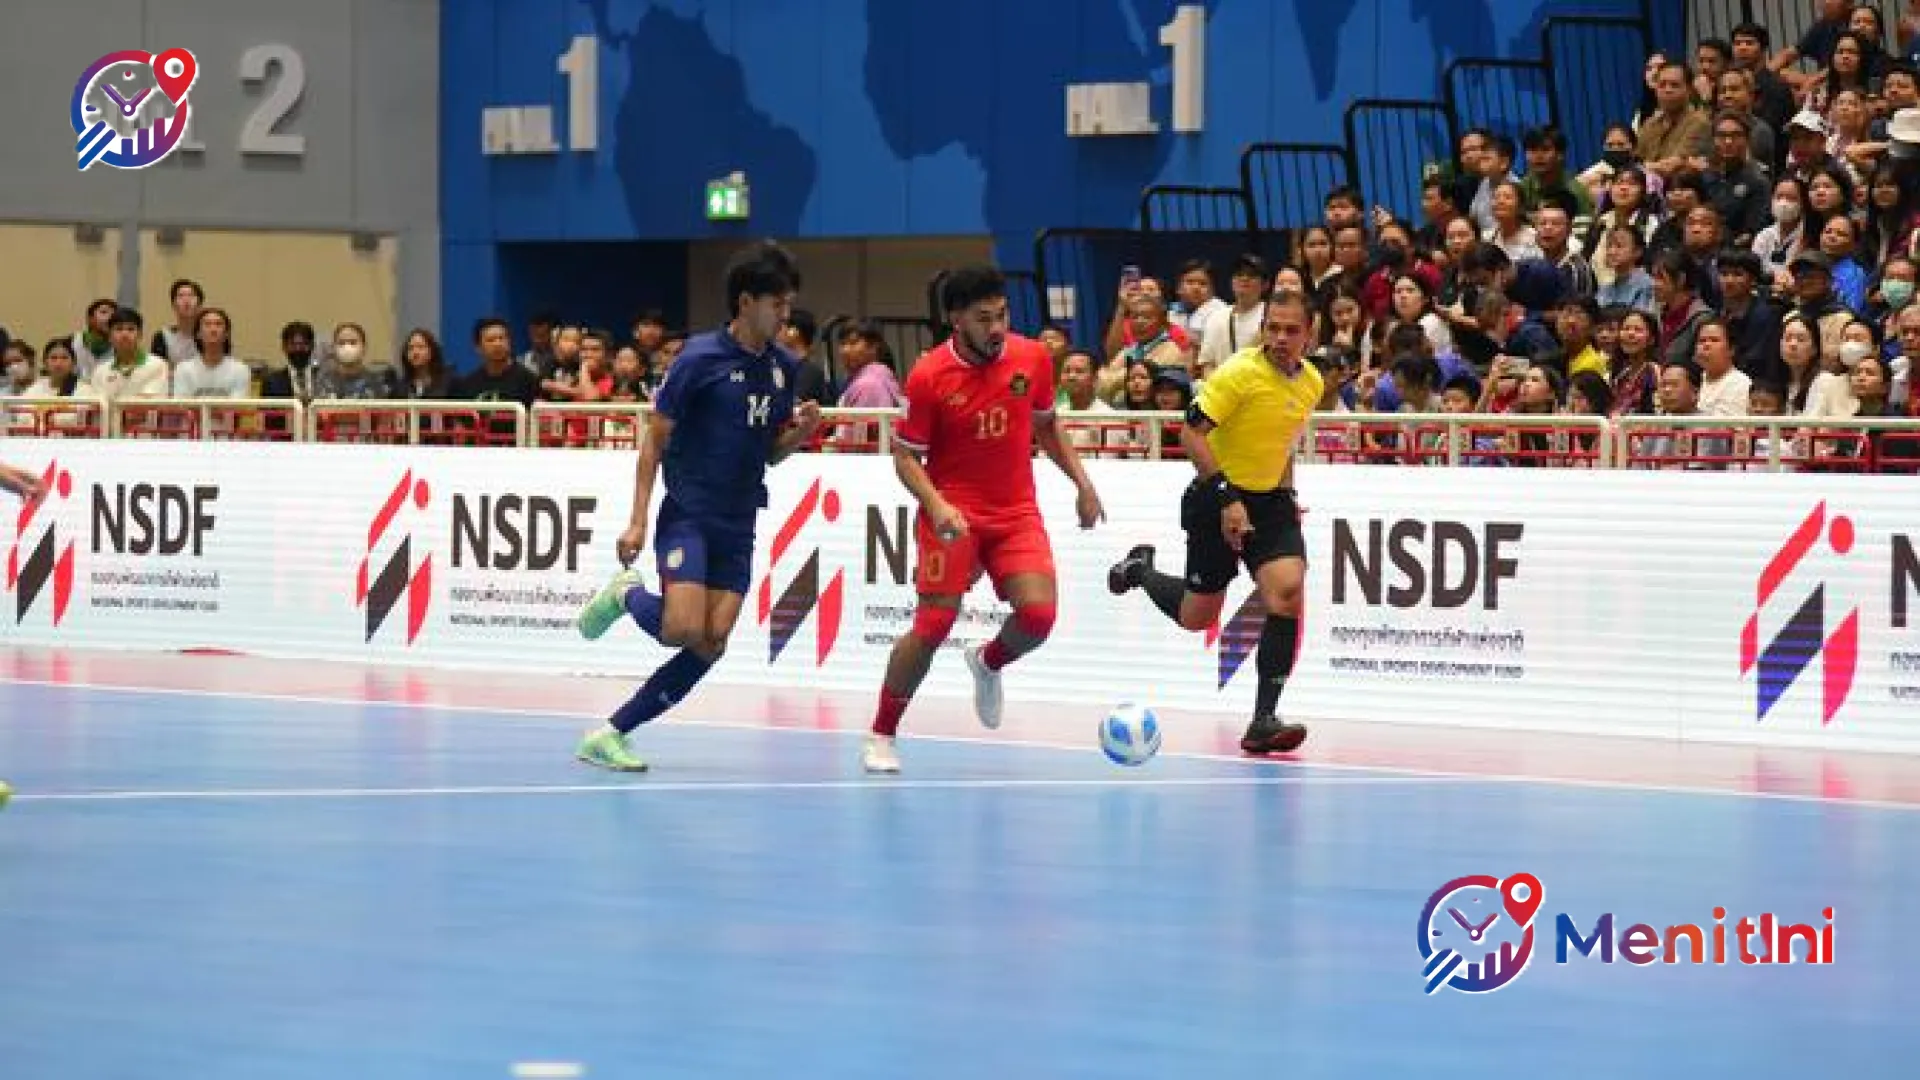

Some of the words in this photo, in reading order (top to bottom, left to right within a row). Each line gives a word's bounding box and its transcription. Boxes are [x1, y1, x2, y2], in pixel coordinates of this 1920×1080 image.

[239, 44, 305, 154] 2
[556, 34, 599, 151] 1
[1158, 5, 1205, 132] 1
[976, 406, 1008, 439] 10
[91, 482, 220, 556] NSDF
[451, 492, 599, 573] NSDF
[1332, 518, 1524, 610] NSDF
